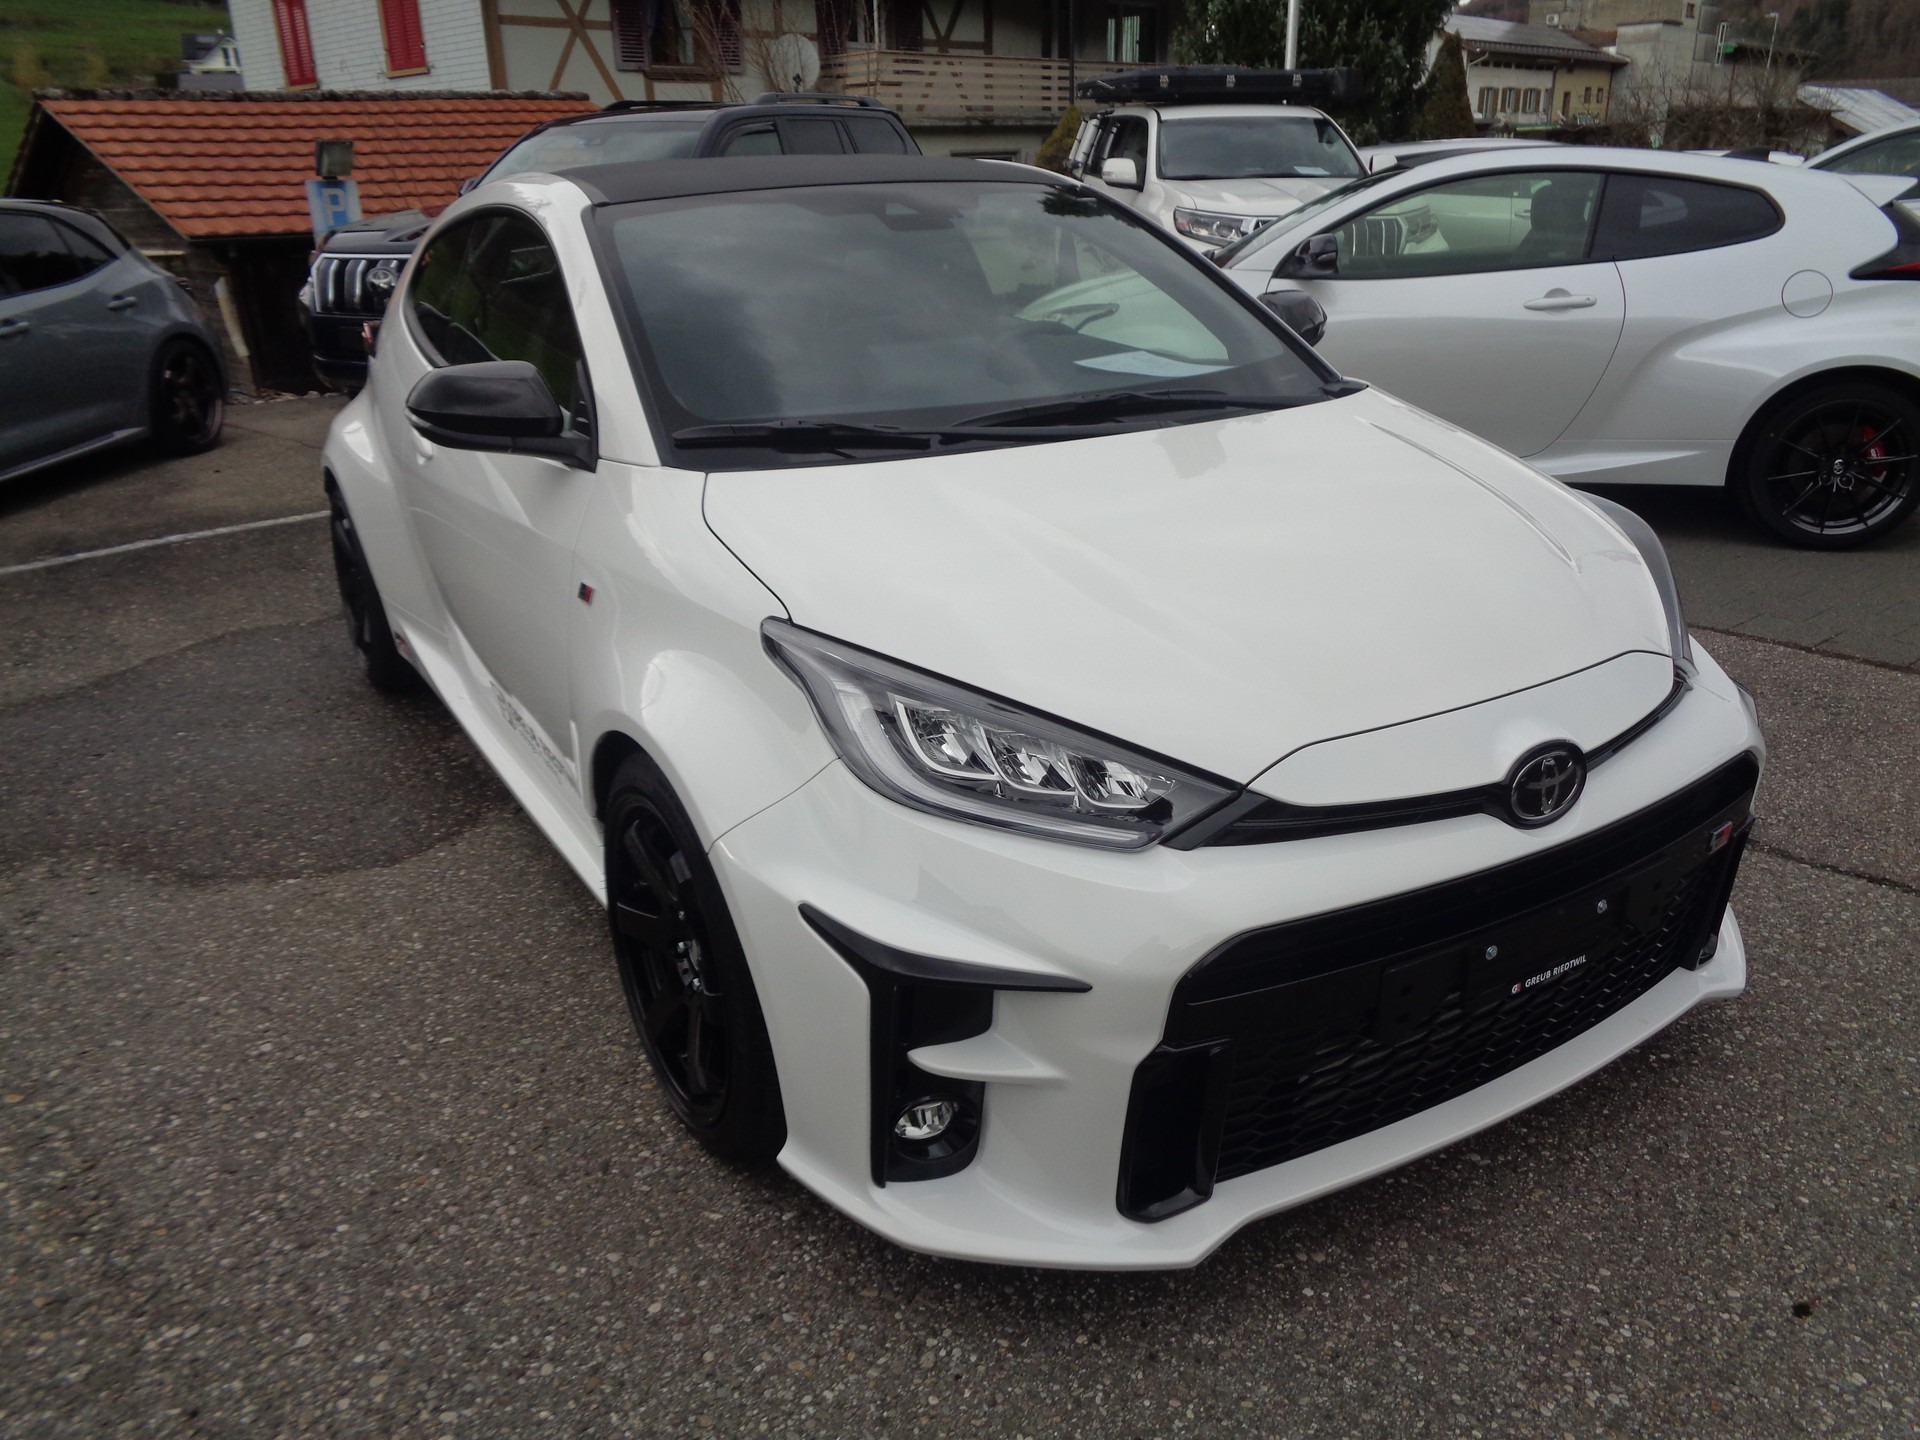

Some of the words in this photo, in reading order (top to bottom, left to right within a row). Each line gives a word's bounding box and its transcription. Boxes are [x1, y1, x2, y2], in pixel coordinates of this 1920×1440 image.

[322, 188, 347, 227] P
[1525, 970, 1551, 988] GREUB
[1553, 954, 1587, 976] RIEDTWIL
